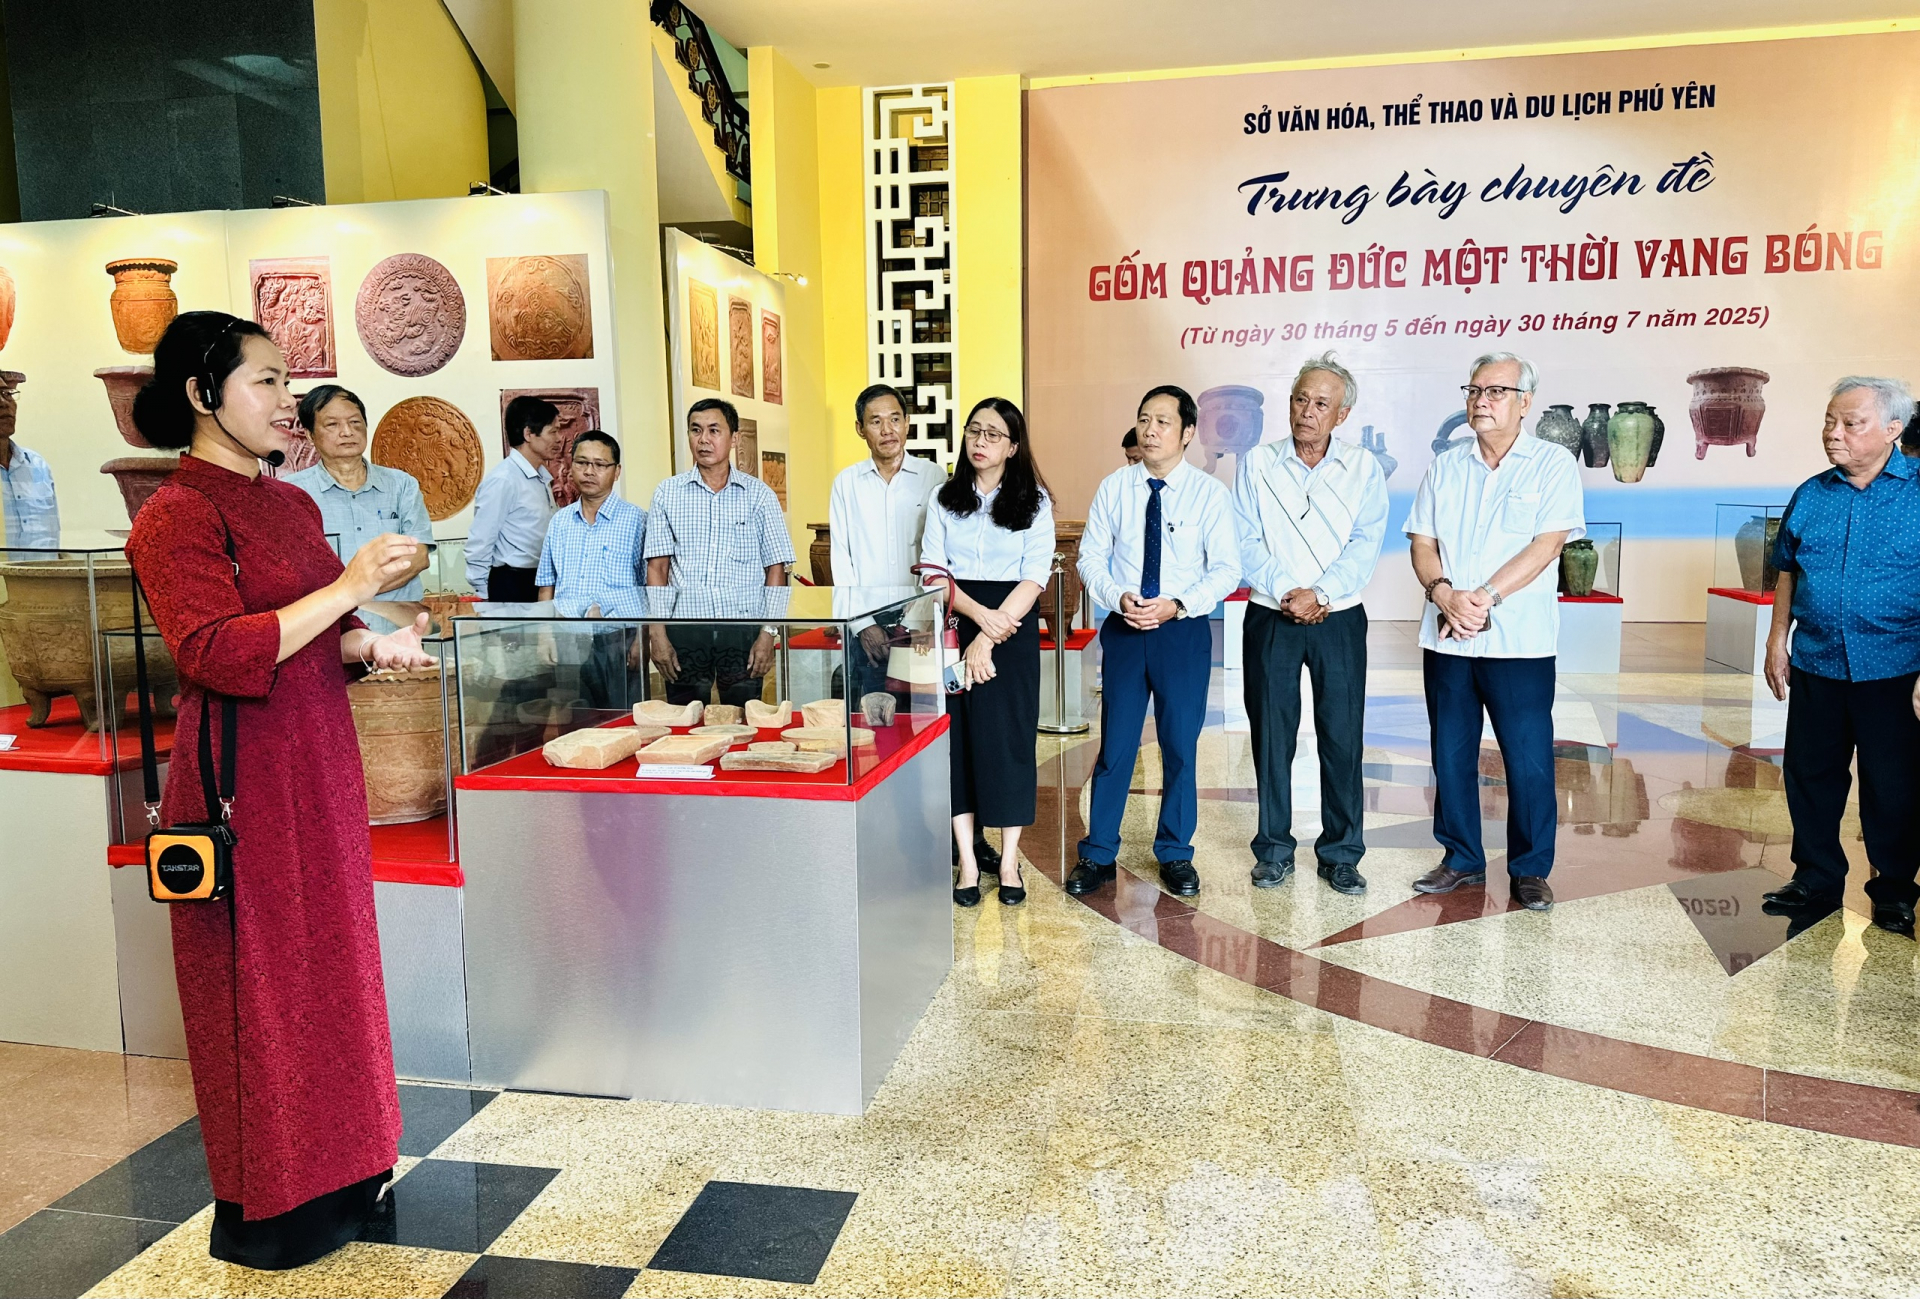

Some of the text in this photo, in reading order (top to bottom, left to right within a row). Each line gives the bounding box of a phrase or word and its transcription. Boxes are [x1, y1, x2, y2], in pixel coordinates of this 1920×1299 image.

[1243, 80, 1716, 135] SỞ VĂN HÓA, THỂ THAO VÀ DU LỊCH PHÚ YÊN
[1237, 150, 1716, 225] Trưng bày chuyên đề
[1089, 222, 1884, 305] GỐM QUẢNG ĐỨC MỘT THỜI VANG BÓNG
[1180, 305, 1770, 349] (Từ ngày 30 tháng 5 đến ngày 30 tháng 7 năm 2025)
[161, 864, 200, 872] TAKSTAR
